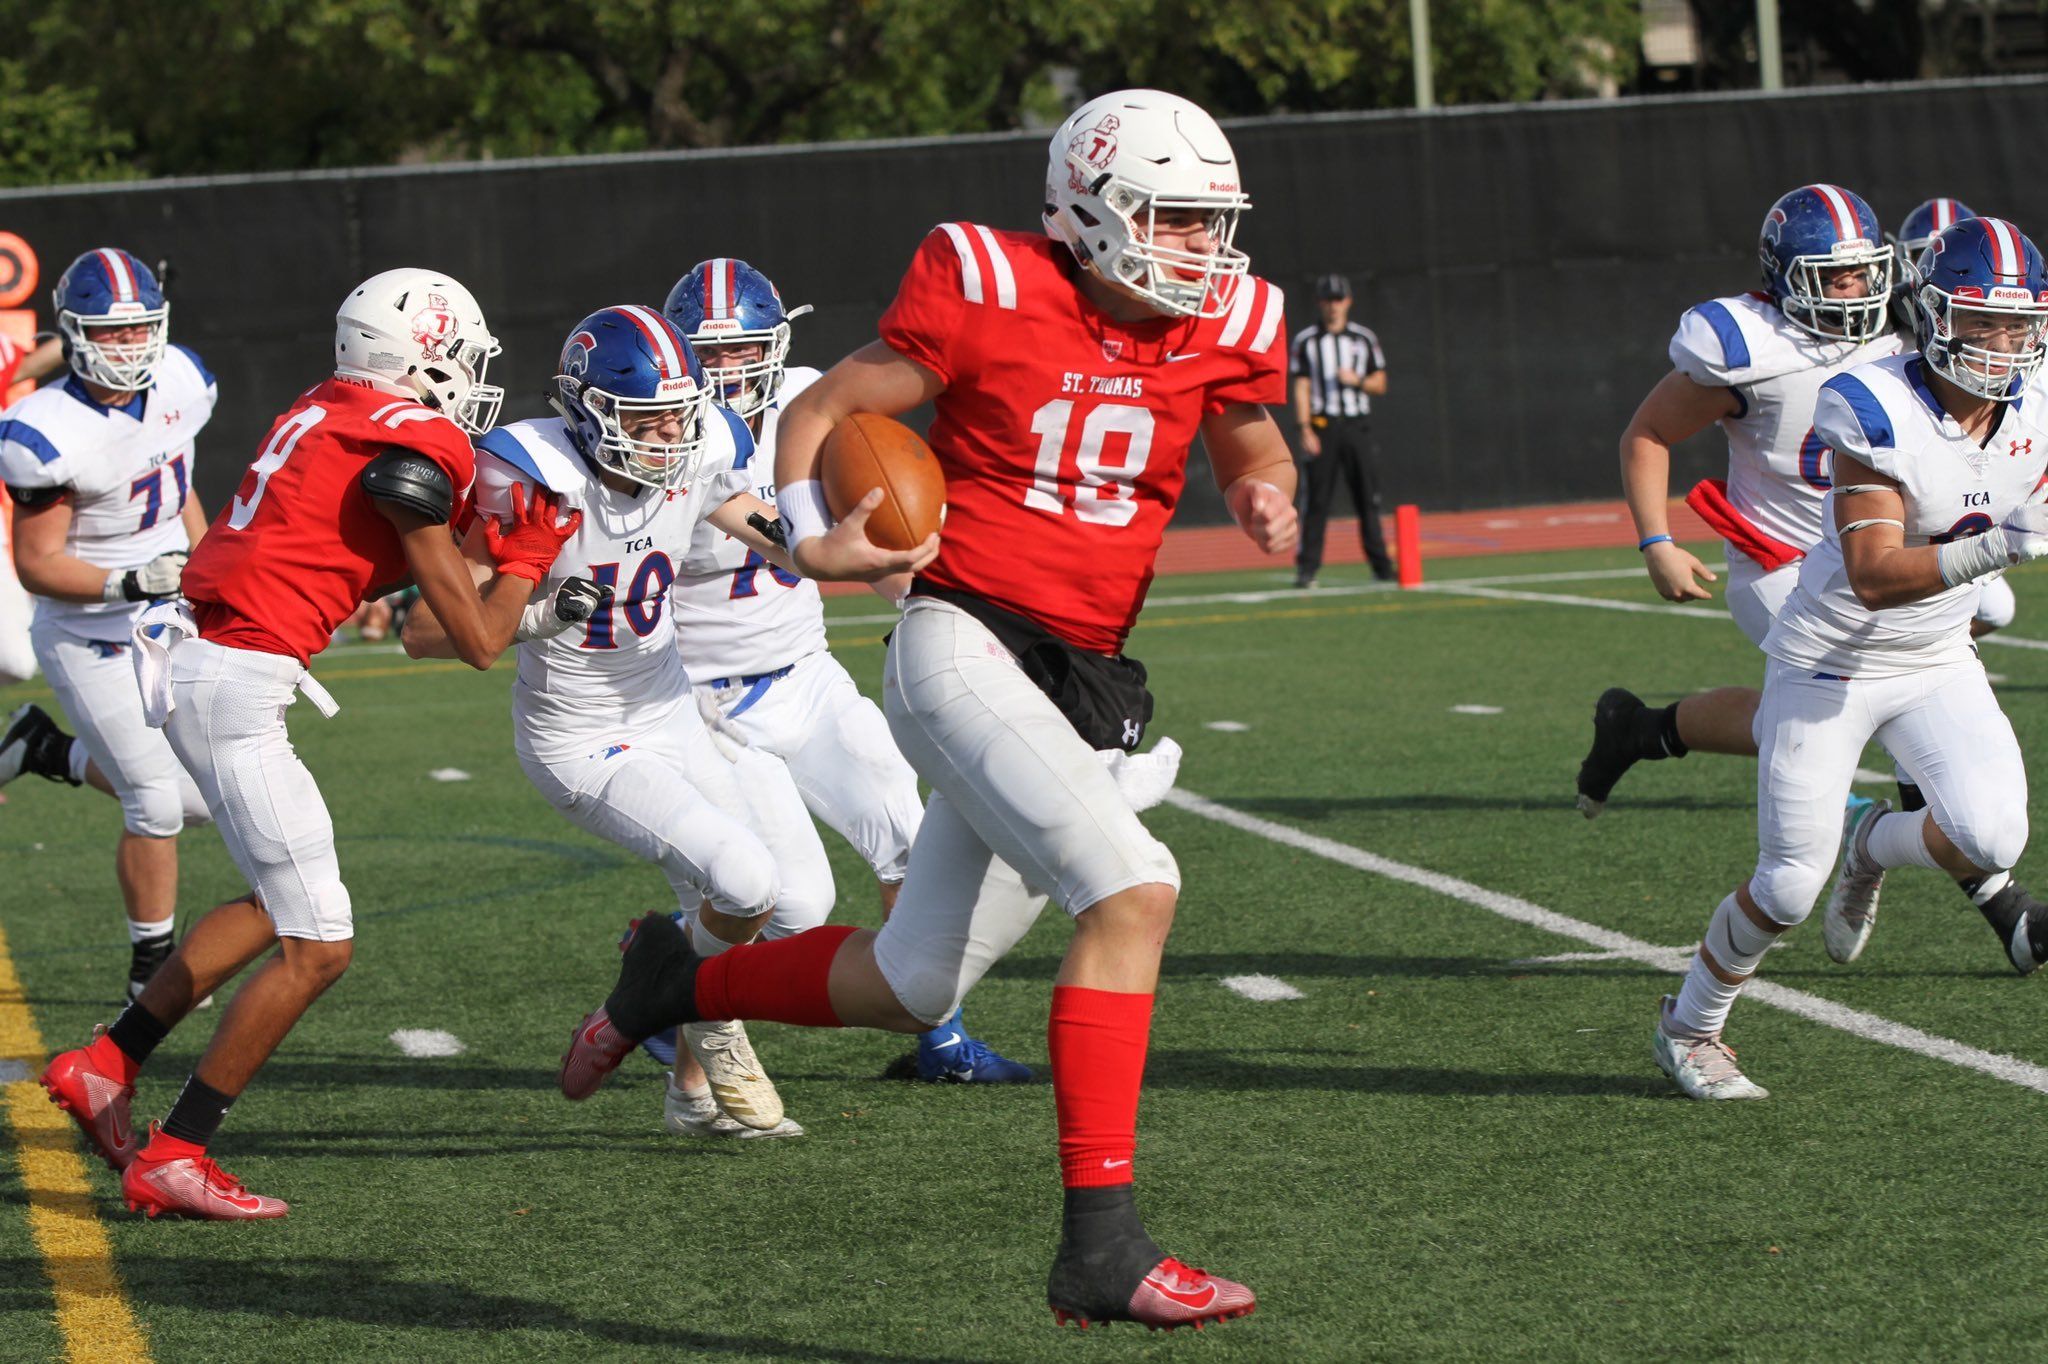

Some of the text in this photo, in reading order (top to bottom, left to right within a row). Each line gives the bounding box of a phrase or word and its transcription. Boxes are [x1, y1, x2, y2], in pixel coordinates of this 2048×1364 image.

[1087, 137, 1107, 160] T
[1209, 181, 1238, 193] Riddell
[1994, 290, 2030, 300] Riddell
[435, 314, 449, 334] T
[662, 379, 693, 392] Riddell
[1061, 371, 1143, 398] ST. THOMAS
[1024, 398, 1156, 527] 18
[129, 453, 188, 532] 71
[758, 484, 777, 500] TC
[1963, 491, 1991, 507] TCA
[625, 536, 653, 554] TCA
[578, 550, 676, 650] 10
